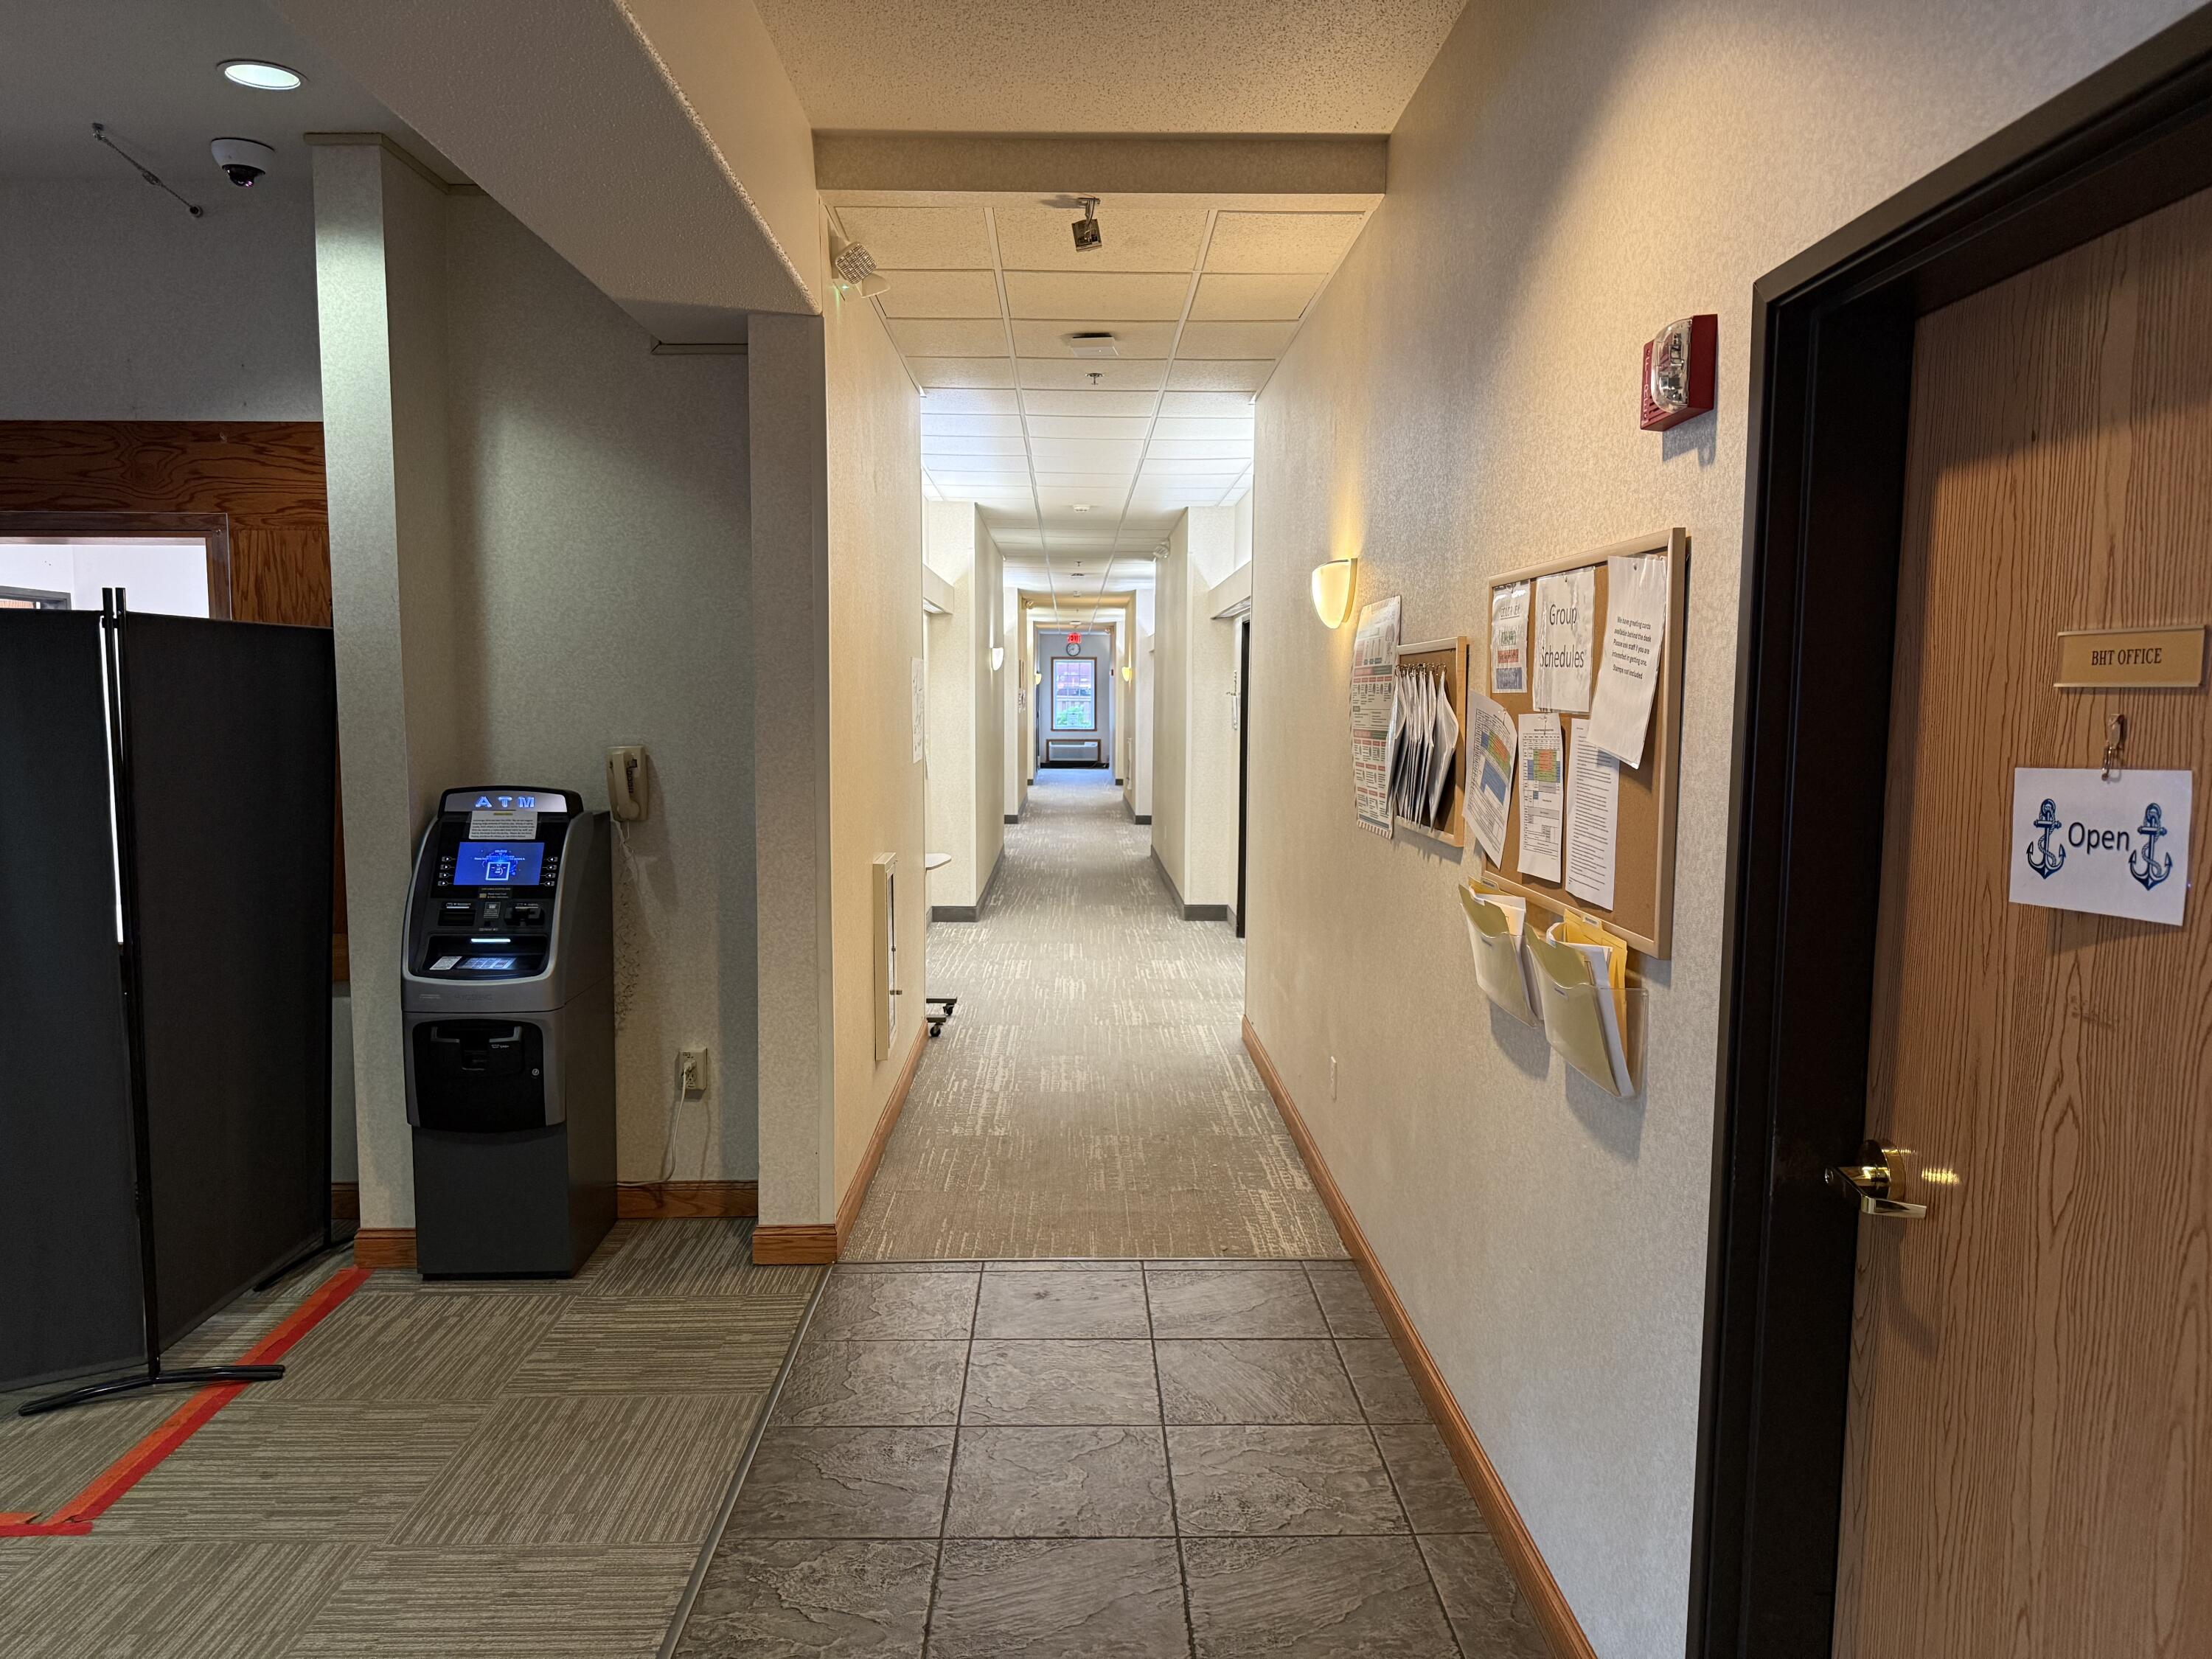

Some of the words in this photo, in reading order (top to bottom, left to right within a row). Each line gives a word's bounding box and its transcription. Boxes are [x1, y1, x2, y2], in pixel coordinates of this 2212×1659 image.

[1549, 604, 1577, 630] Group
[1629, 620, 1642, 629] greeting
[1614, 628, 1627, 636] available
[1627, 631, 1638, 639] behind
[1613, 639, 1623, 647] Please
[1540, 644, 1584, 668] Schedules
[1630, 656, 1641, 666] getting
[2091, 650, 2115, 666] BHT
[2118, 647, 2163, 665] OFFICE
[1613, 664, 1624, 675] Stamps
[475, 796, 535, 808] ATM
[2068, 821, 2129, 855] Open
